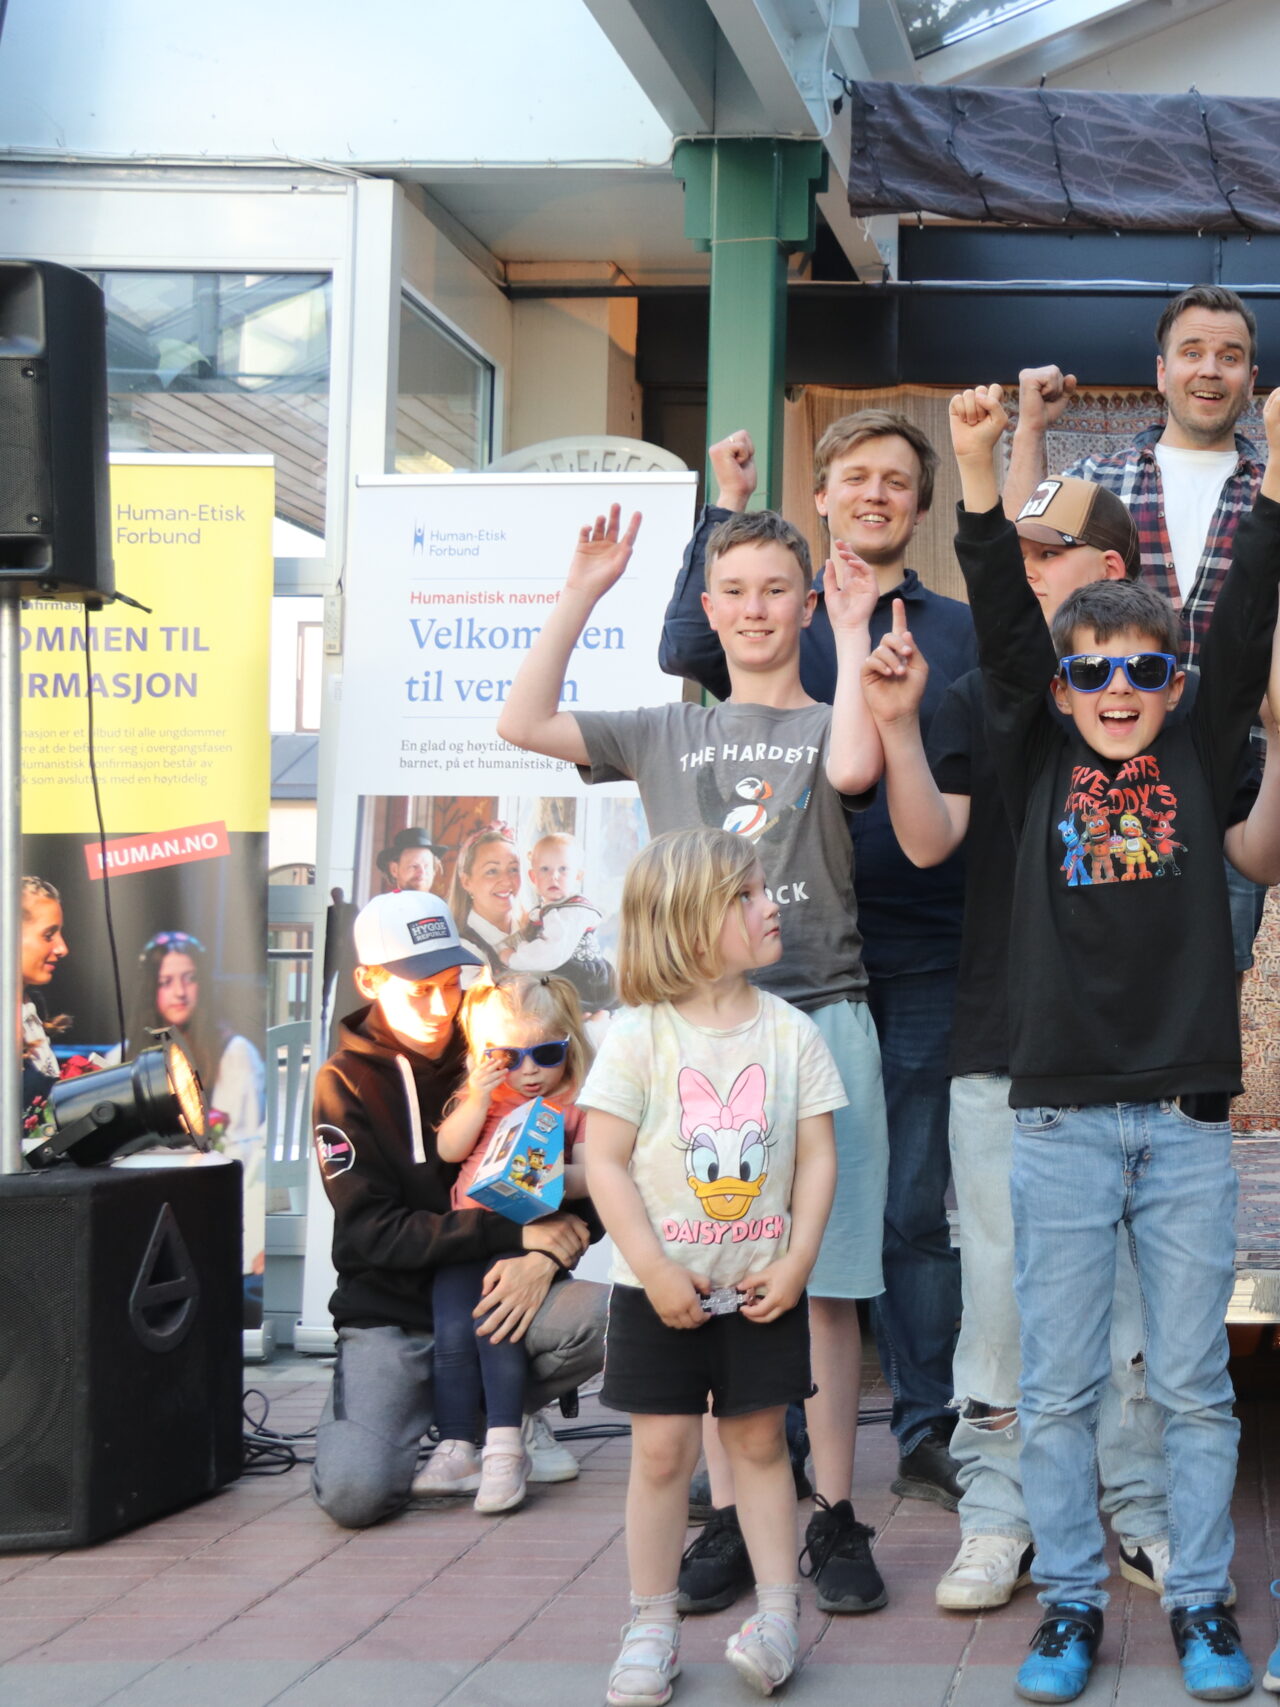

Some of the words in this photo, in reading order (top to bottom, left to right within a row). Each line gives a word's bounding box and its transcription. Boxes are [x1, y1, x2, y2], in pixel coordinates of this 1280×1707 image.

[117, 504, 246, 521] Human-Etisk
[117, 528, 201, 544] Forbund
[430, 529, 507, 541] Human-Etisk
[429, 545, 480, 556] Forbund
[410, 591, 504, 604] Humanistisk
[509, 590, 561, 604] navnef
[159, 626, 210, 652] TIL
[409, 617, 625, 650] Velkomen
[405, 670, 443, 702] til
[455, 680, 579, 702] vern
[401, 740, 417, 751] En
[420, 740, 446, 754] glad
[449, 742, 464, 754] og
[400, 757, 442, 769] barnet,
[463, 759, 475, 769] et
[478, 758, 553, 769] humanistisk
[680, 747, 716, 772] THE
[722, 742, 819, 765] HARDEST
[97, 832, 219, 870] HUMAN.NO
[663, 1219, 730, 1244] DAISY
[731, 1215, 784, 1243] DUCK
